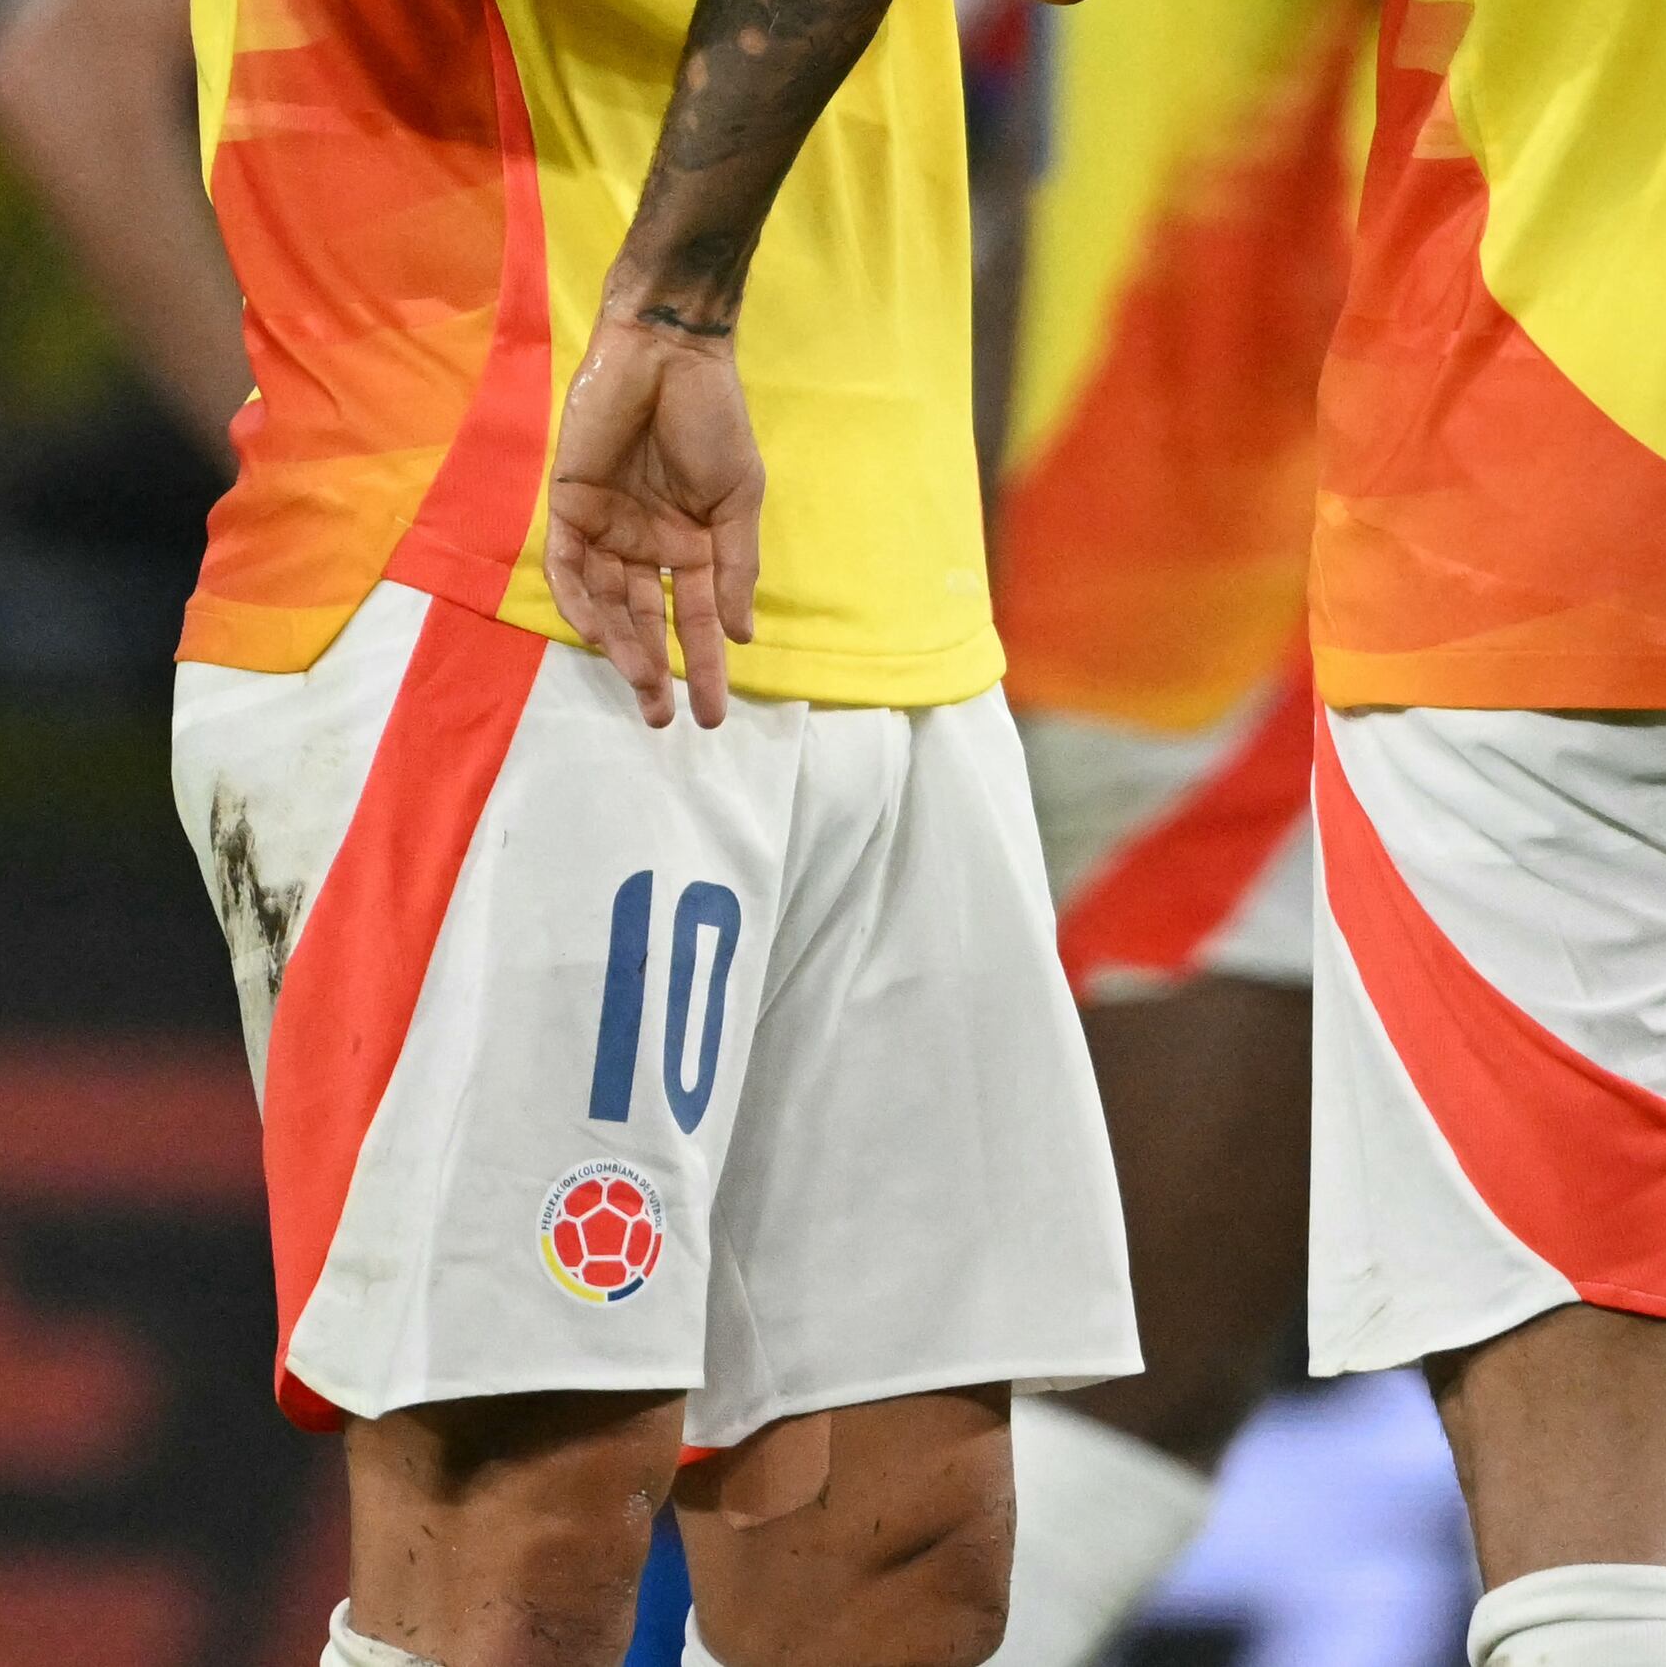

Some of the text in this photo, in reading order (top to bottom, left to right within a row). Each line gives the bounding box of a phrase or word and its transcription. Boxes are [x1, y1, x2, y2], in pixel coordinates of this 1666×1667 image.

[589, 870, 741, 1135] 10
[578, 1163, 640, 1183] COLOMBIANA
[639, 1179, 651, 1192] DE
